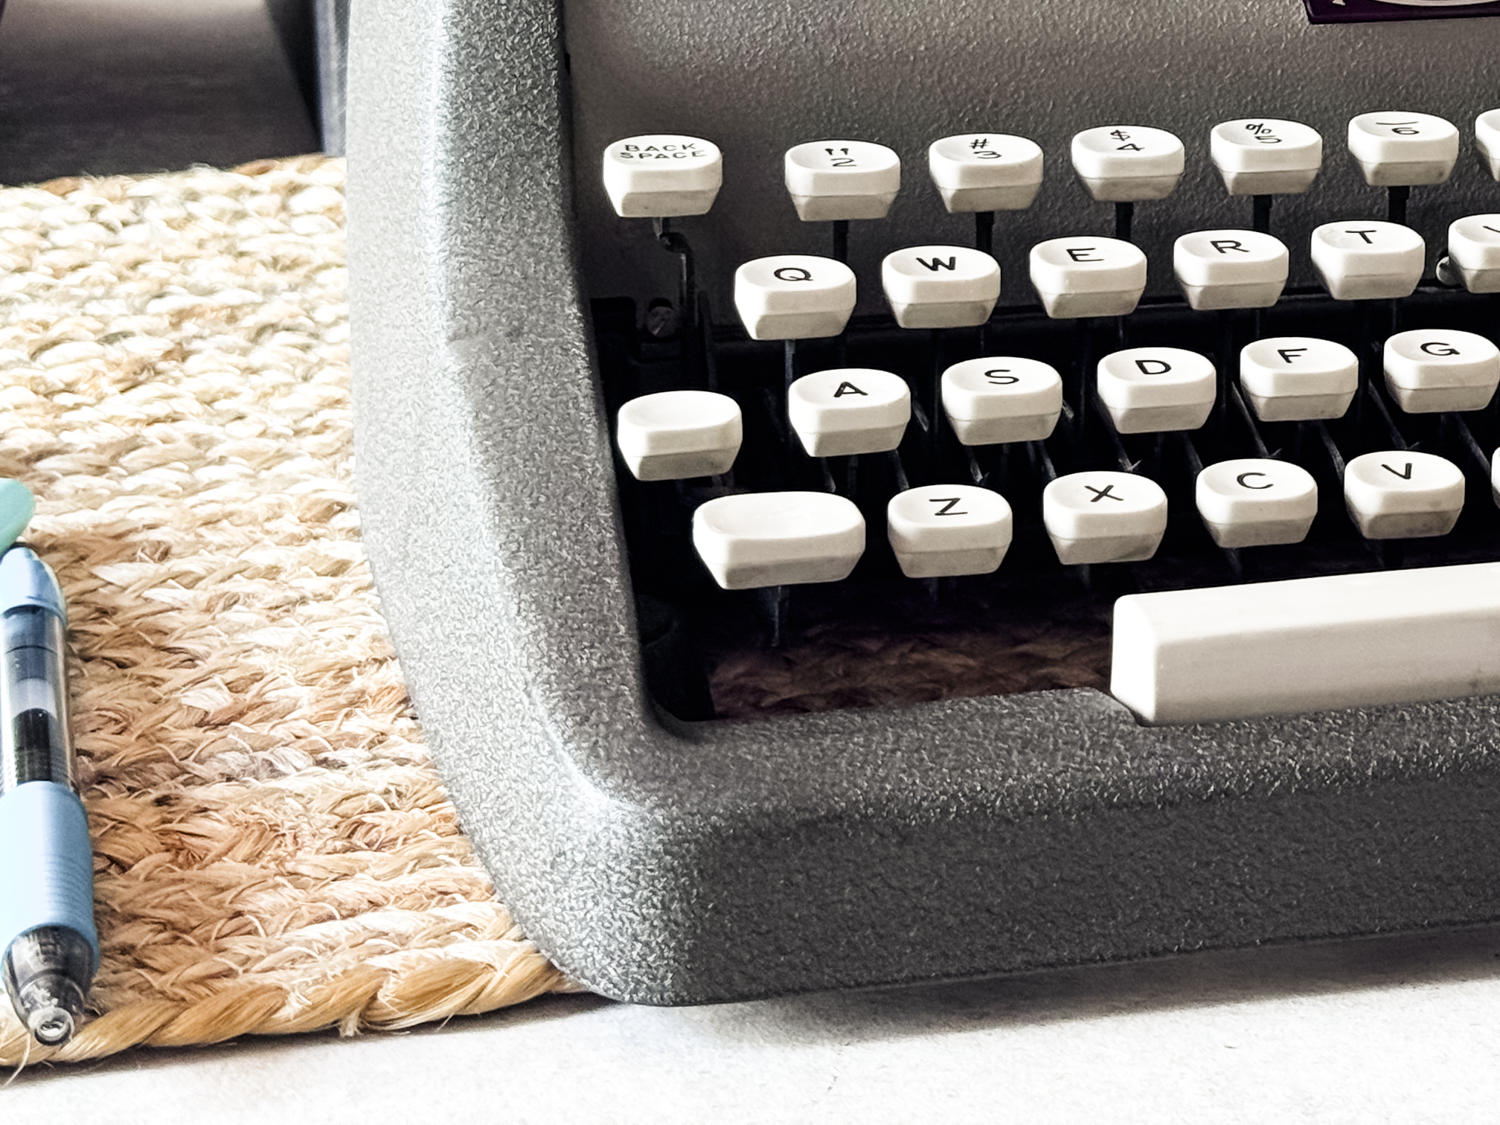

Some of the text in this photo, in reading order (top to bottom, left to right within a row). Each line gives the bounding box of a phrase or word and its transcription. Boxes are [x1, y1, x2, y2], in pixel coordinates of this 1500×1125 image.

[1109, 129, 1131, 142] $
[1245, 122, 1273, 136] %
[969, 137, 990, 150] #
[1115, 142, 1145, 152] 4
[1253, 134, 1284, 144] 5
[620, 150, 706, 159] SPACE
[624, 143, 697, 152] BACK
[972, 150, 1003, 160] 3
[830, 157, 858, 168] 2
[1344, 229, 1378, 245] T
[1065, 247, 1105, 263] E
[1209, 239, 1251, 255] R
[915, 255, 957, 272] W
[773, 266, 814, 282] Q
[1276, 347, 1309, 364] F
[1419, 341, 1461, 357] G
[1134, 359, 1173, 376] D
[983, 368, 1020, 386] S
[832, 380, 869, 399] A
[1380, 462, 1413, 481] V
[1236, 471, 1274, 490] C
[1083, 484, 1125, 503] X
[928, 497, 969, 517] Z
